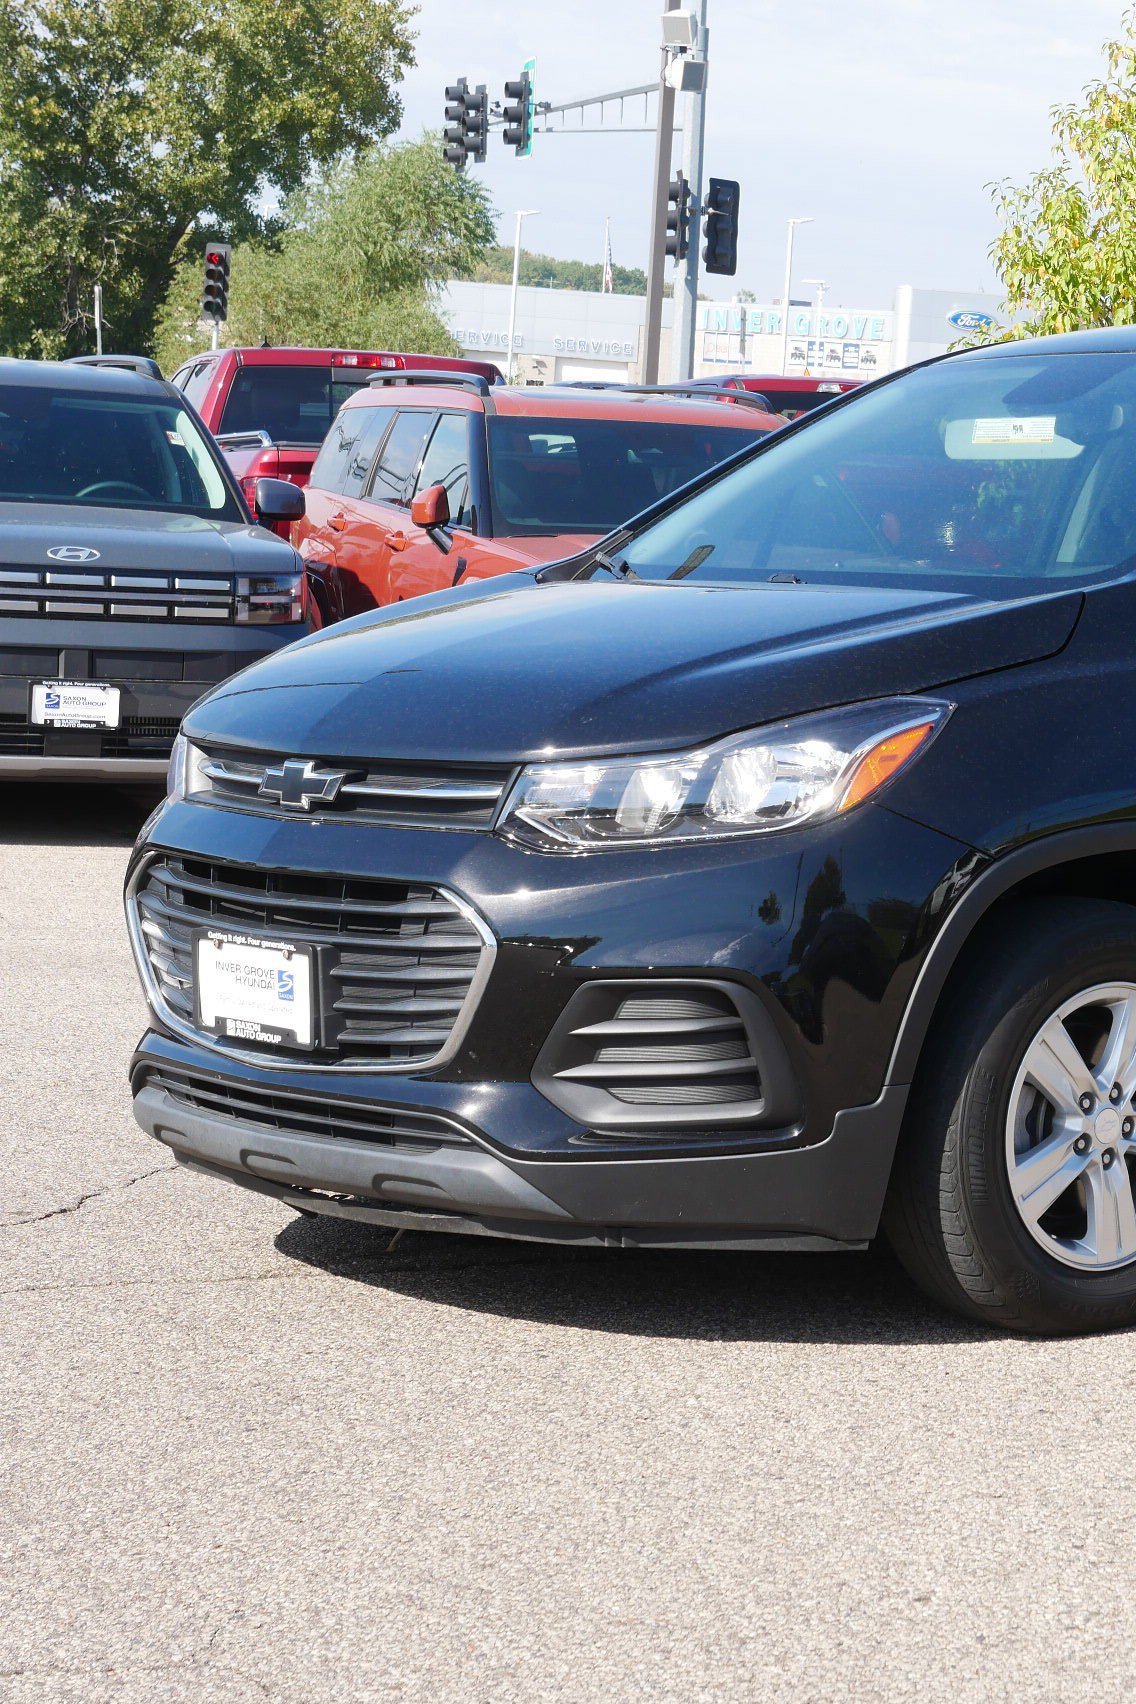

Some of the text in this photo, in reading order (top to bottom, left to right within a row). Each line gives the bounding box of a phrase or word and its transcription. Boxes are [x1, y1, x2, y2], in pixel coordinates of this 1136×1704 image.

[702, 308, 885, 340] INVER GROVE
[450, 330, 524, 347] ERVICE
[553, 338, 633, 355] SERVICE
[207, 930, 228, 943] Getting
[247, 937, 261, 946] Four
[215, 961, 275, 980] INVER GROVE
[235, 975, 276, 990] HYUNDAI
[235, 1020, 261, 1032] SAXON
[235, 1028, 282, 1043] AUTO GROUP
